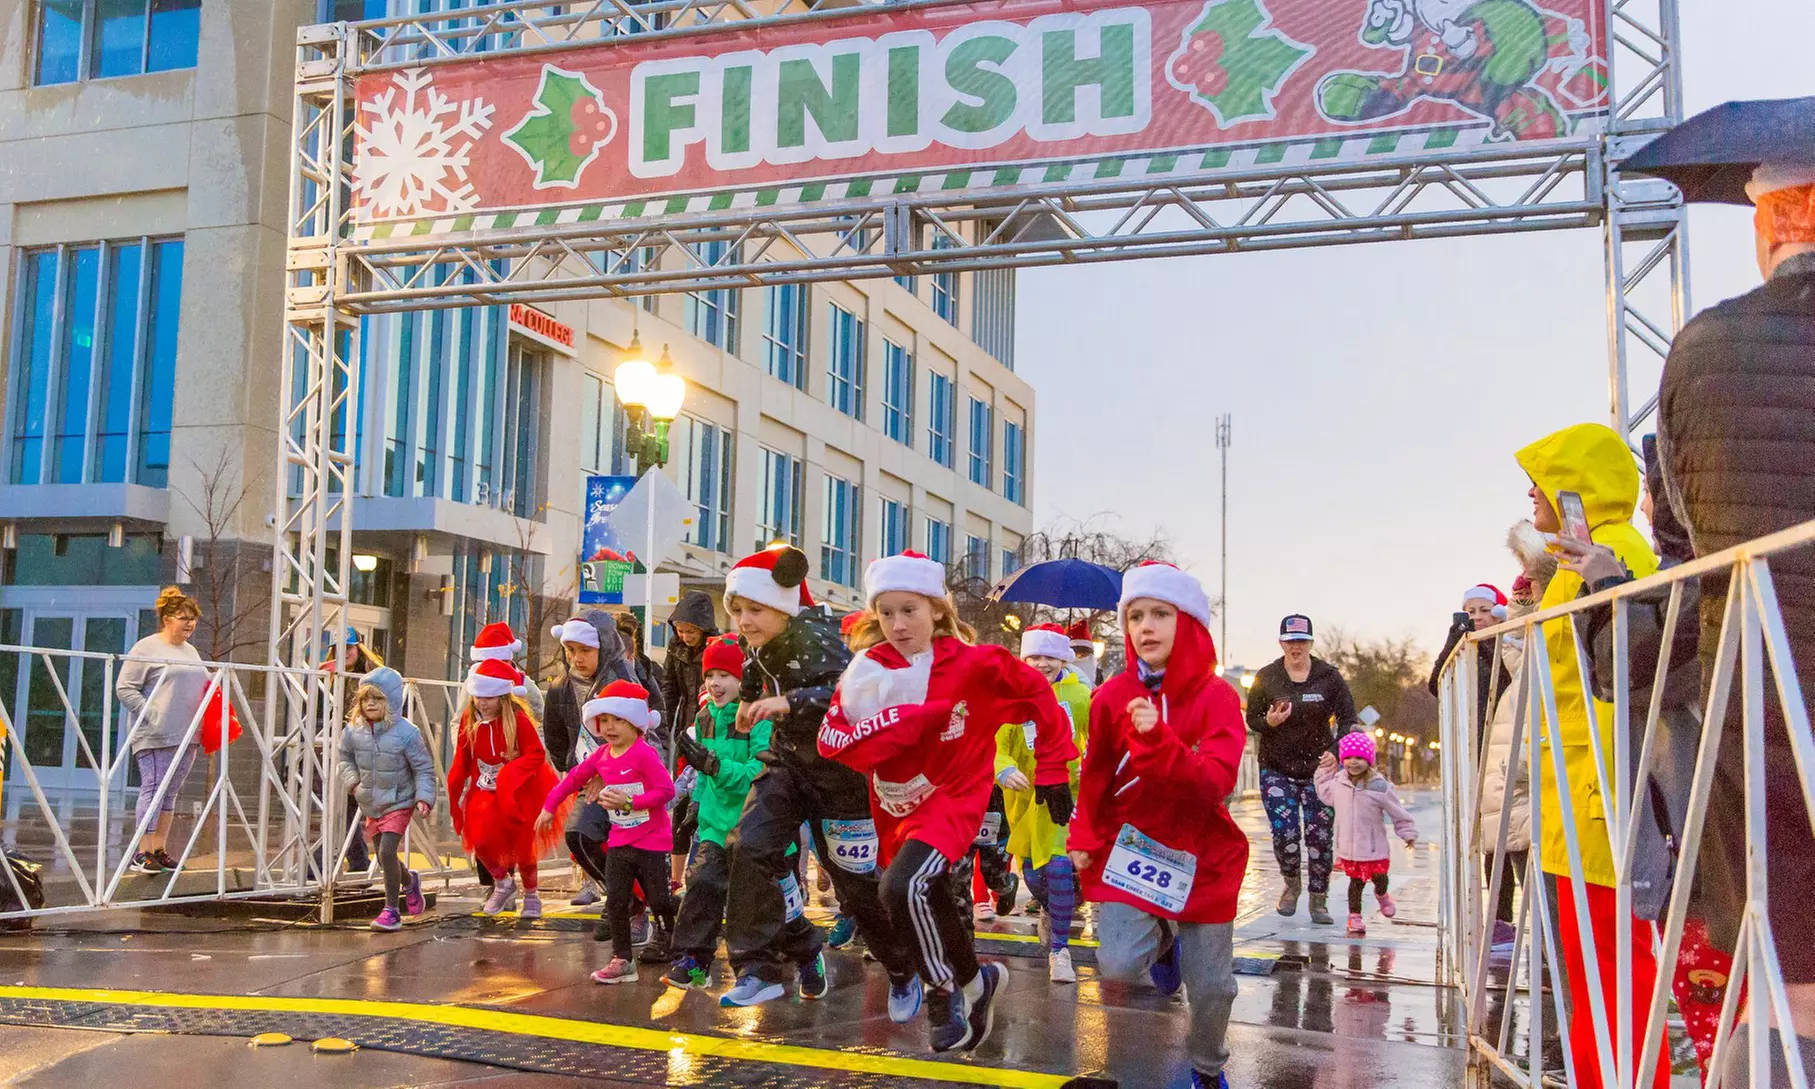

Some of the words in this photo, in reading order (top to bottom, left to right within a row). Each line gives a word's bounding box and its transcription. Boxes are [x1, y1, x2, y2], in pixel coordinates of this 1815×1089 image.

[642, 22, 1135, 163] FINISH
[525, 308, 575, 348] COLLEGE
[608, 561, 632, 571] DOWN
[852, 707, 900, 741] USTLE
[836, 844, 870, 859] 642
[1127, 859, 1172, 889] 628
